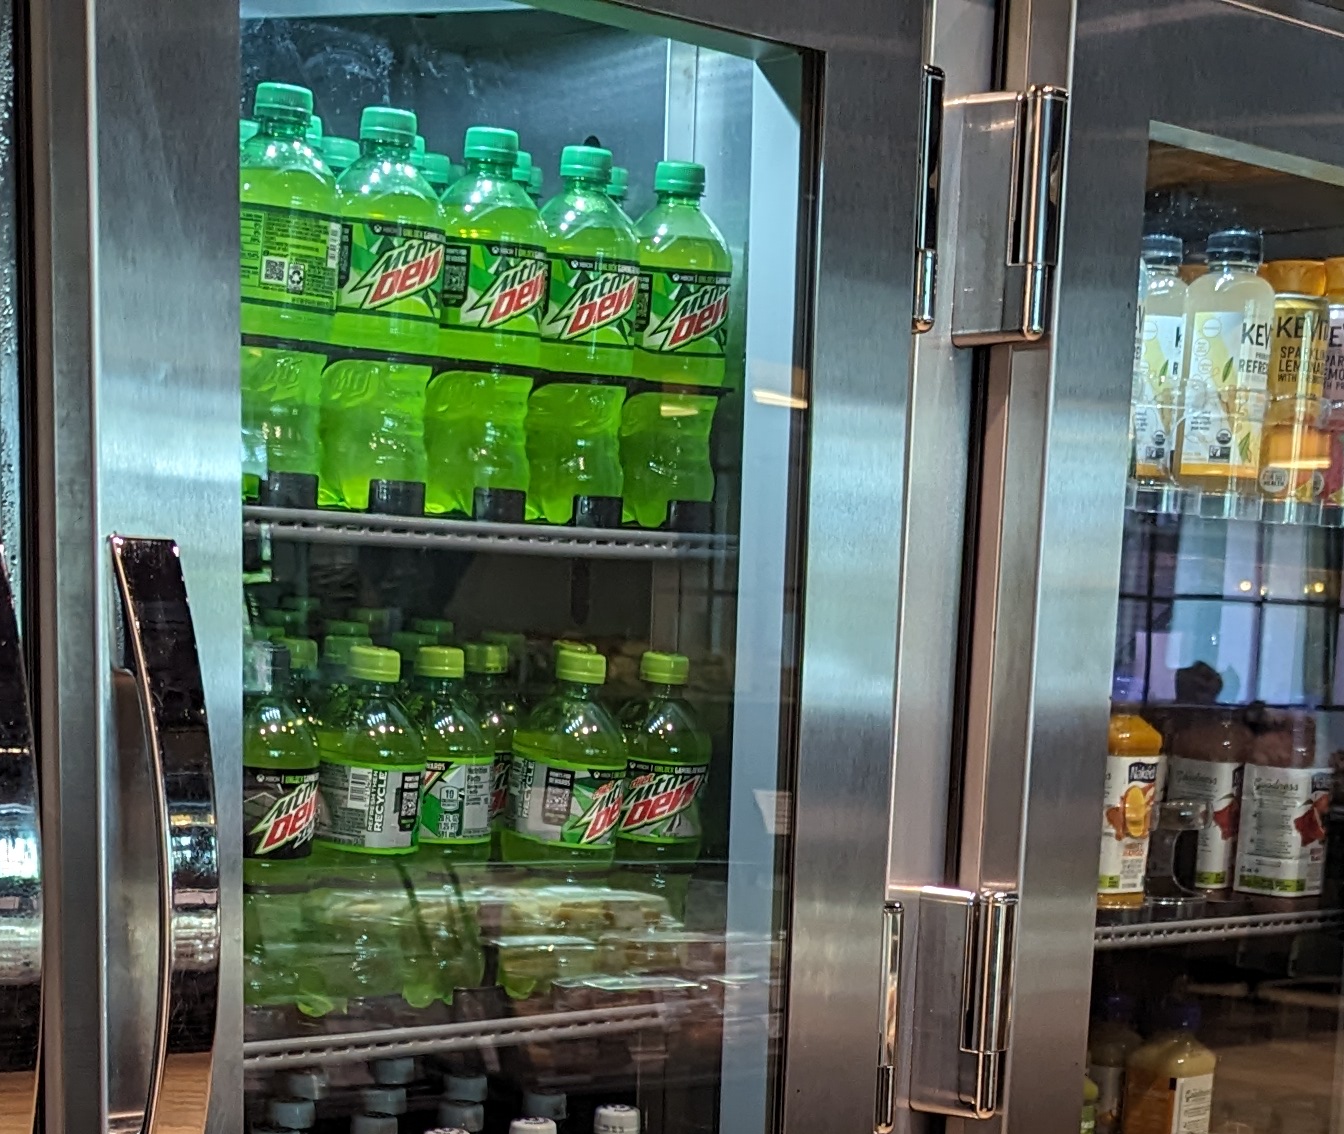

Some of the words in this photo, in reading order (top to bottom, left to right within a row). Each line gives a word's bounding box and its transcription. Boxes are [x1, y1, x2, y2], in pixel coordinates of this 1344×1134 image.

[371, 770, 379, 792] THEN
[1130, 765, 1157, 781] Naked
[373, 771, 388, 832] RECYCLE
[445, 789, 455, 799] 10
[367, 793, 376, 832] REFRESH
